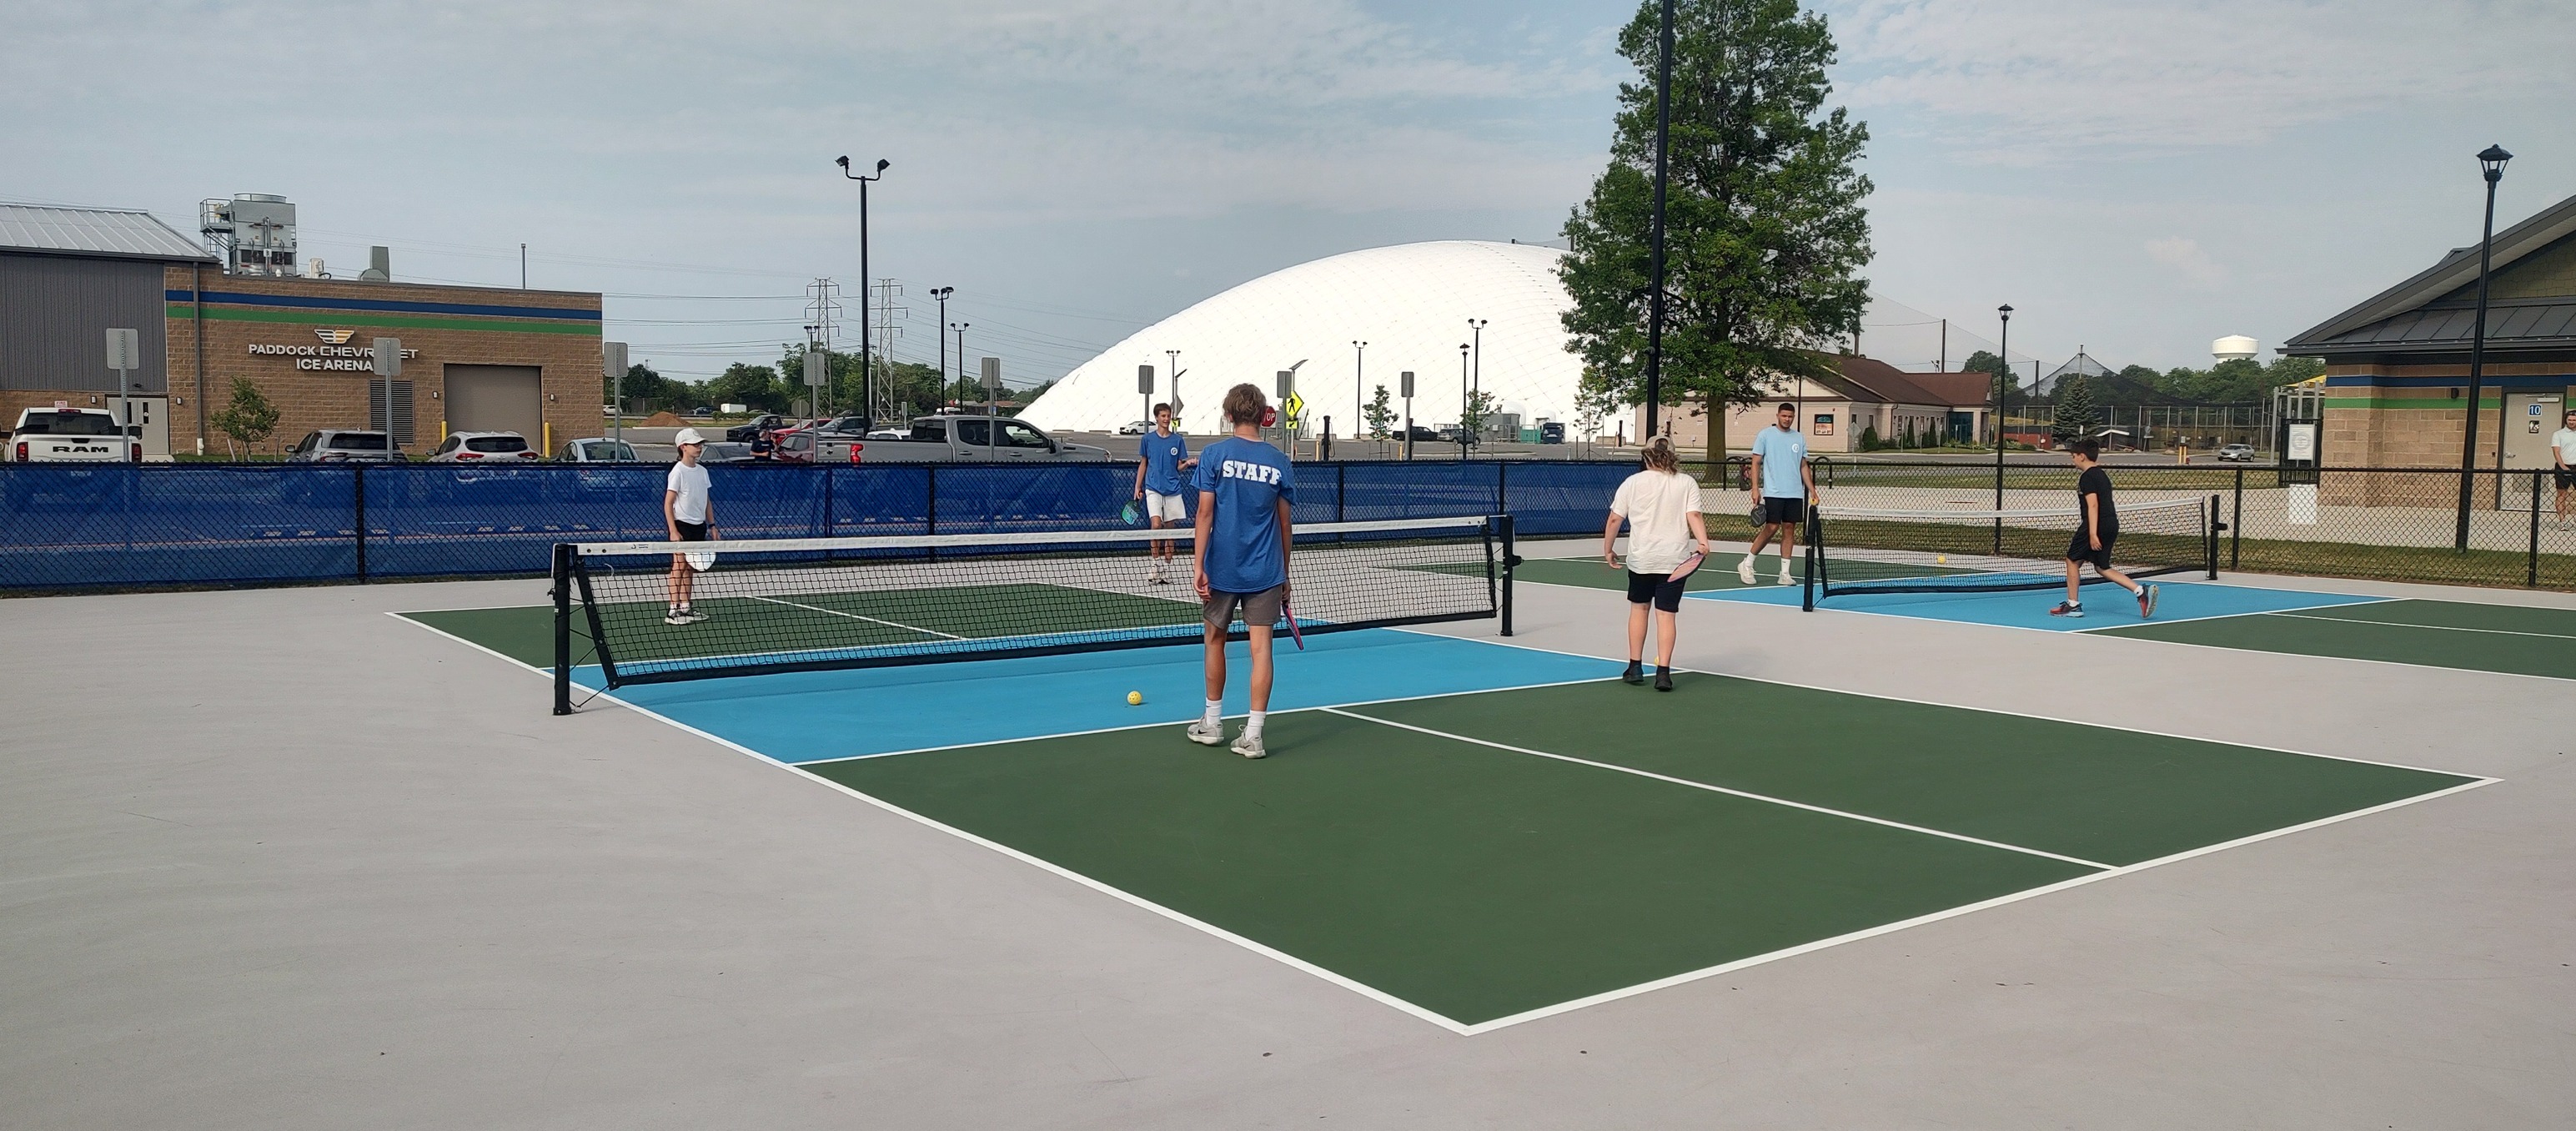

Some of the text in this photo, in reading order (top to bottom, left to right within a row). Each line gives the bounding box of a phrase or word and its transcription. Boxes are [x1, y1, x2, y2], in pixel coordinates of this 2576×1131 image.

[249, 344, 419, 359] PADDOCK CHEVRET
[296, 359, 374, 371] ICE ARENA
[2530, 405, 2541, 415] 10
[1266, 413, 1276, 421] OP
[1223, 460, 1282, 485] STAFF
